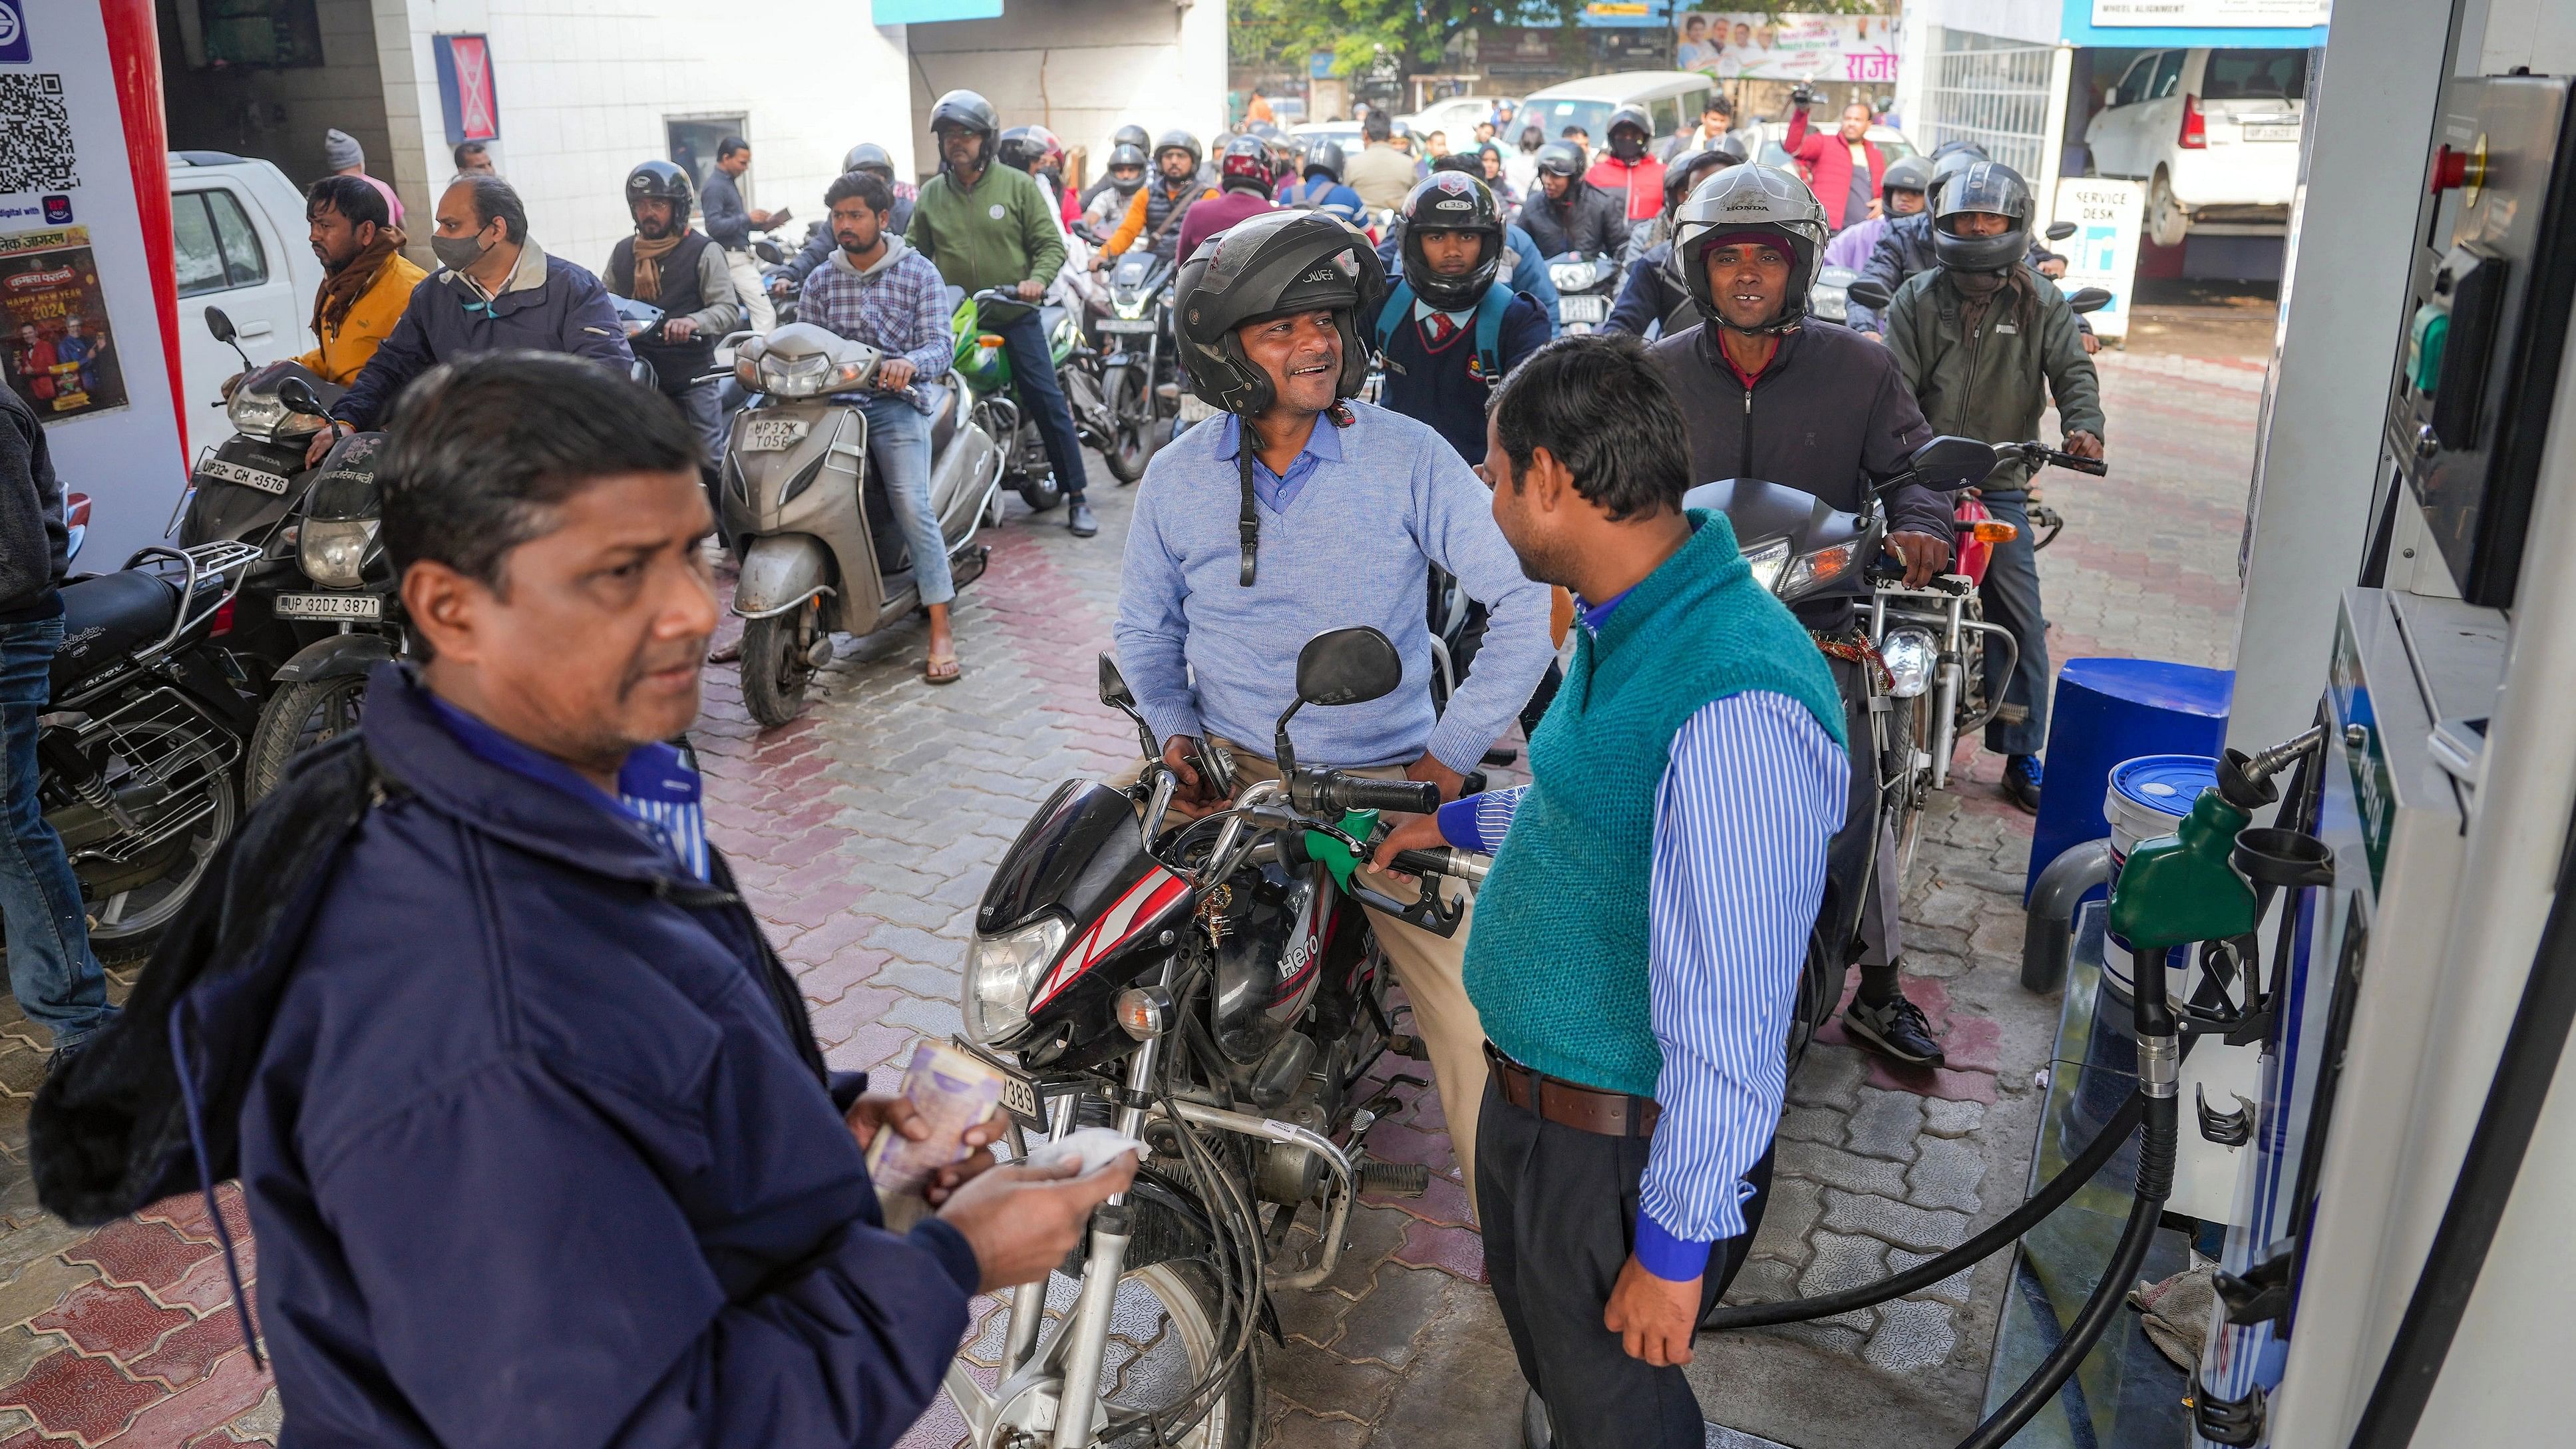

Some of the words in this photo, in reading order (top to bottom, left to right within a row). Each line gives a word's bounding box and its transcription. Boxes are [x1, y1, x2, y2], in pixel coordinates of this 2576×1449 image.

[2076, 192, 2127, 204] SERVICE
[2083, 208, 2114, 219] DESK
[60, 288, 82, 298] YEAR
[32, 302, 67, 319] 2024
[248, 453, 280, 466] HONDA
[203, 461, 226, 476] UP32
[234, 469, 250, 482] CH
[256, 475, 284, 491] 3576
[288, 598, 301, 611] UP
[344, 600, 375, 614] 3871
[2335, 628, 2356, 723] Petrol
[2358, 728, 2386, 853] Petrol
[1276, 934, 1319, 980] Hero
